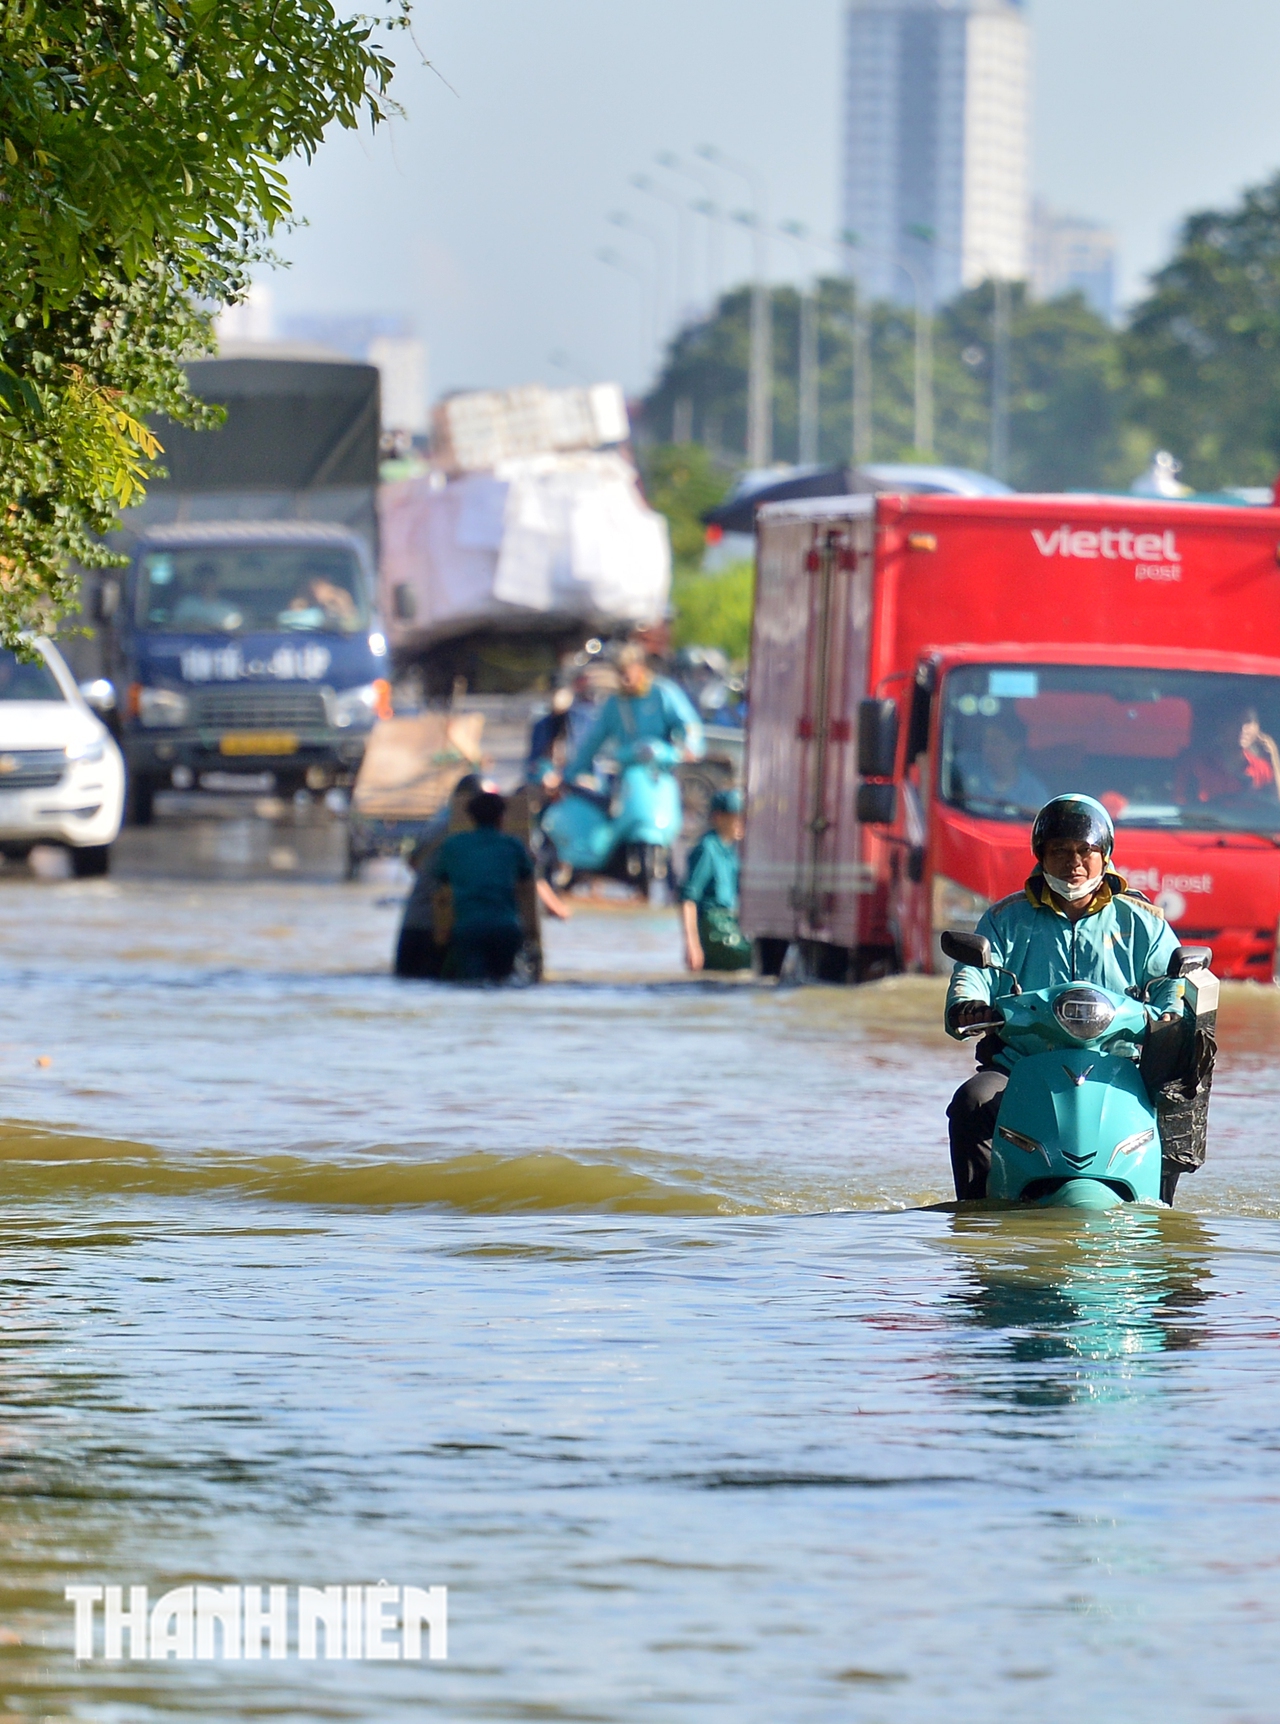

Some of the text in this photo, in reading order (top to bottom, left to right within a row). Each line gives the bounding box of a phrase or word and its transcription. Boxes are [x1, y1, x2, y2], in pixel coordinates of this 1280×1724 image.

[1031, 523, 1182, 562] viettel
[1135, 564, 1182, 582] post
[1161, 874, 1212, 894] post
